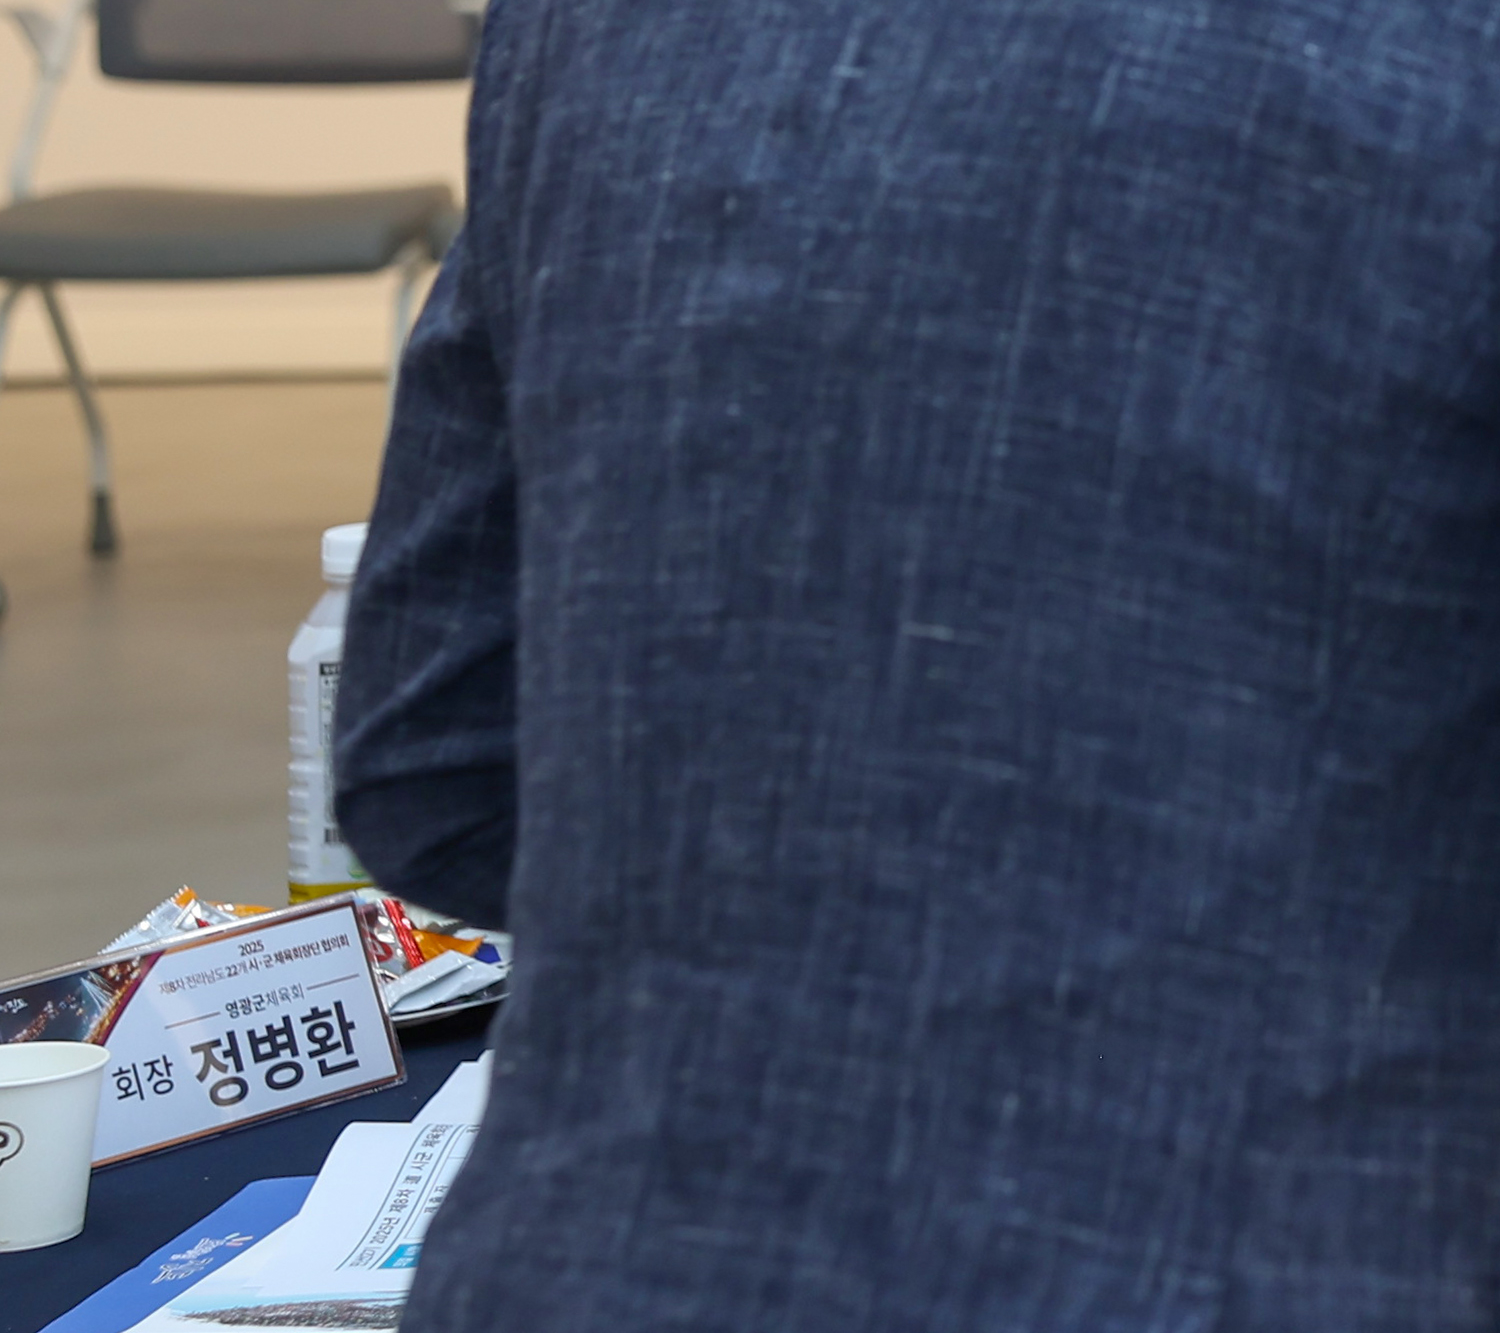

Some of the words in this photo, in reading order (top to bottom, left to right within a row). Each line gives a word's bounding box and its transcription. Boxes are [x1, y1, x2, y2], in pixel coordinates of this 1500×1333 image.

[159, 977, 186, 995] 제8차
[186, 967, 225, 986] 전라남도
[225, 960, 249, 977] 22개
[273, 943, 321, 966] 체육회장단
[322, 933, 350, 953] 협의회
[238, 940, 264, 957] 2025
[225, 983, 305, 1019] 영광군체육회
[111, 1054, 174, 1101] 회장
[190, 1000, 360, 1107] 정병환
[370, 1217, 400, 1244] 2025년
